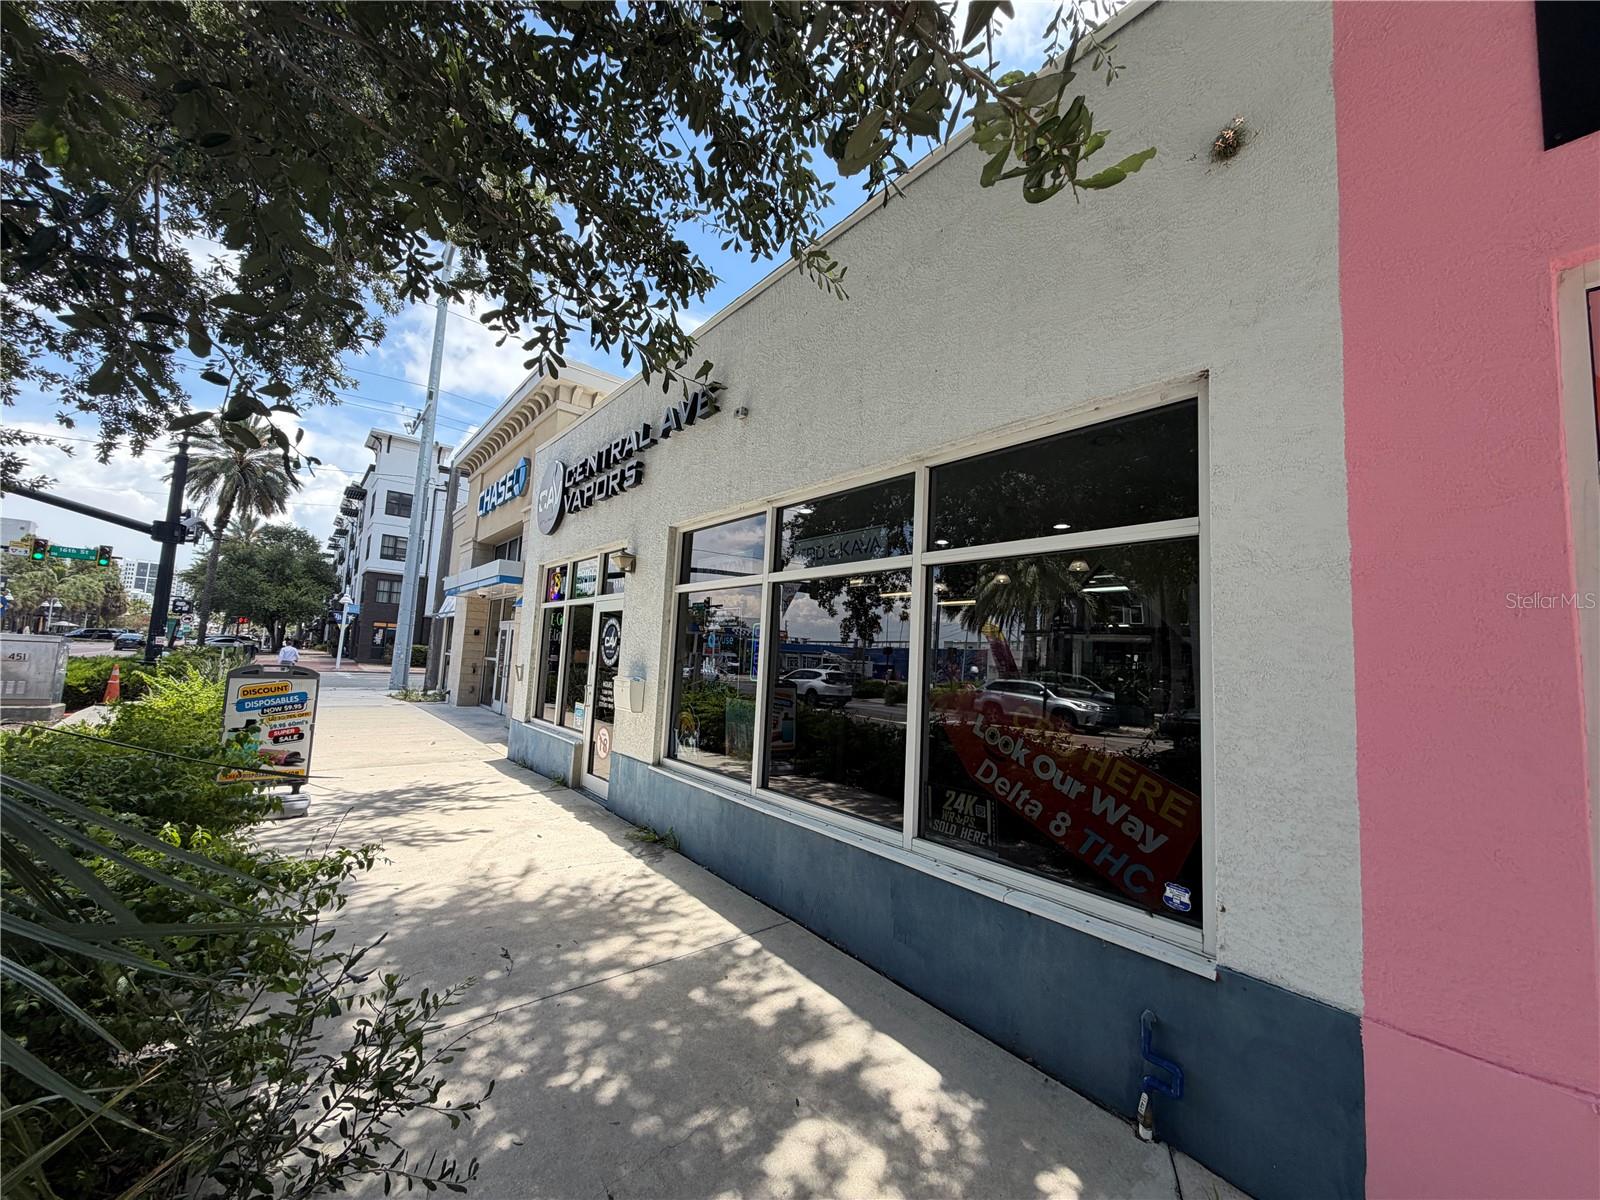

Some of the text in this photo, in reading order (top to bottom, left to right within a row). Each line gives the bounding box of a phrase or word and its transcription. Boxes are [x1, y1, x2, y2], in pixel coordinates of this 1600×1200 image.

[565, 386, 720, 488] CENTRAL AVE
[477, 469, 516, 517] CHASE
[539, 472, 562, 512] CAV
[564, 460, 644, 514] VAPORS
[840, 535, 881, 557] KAVA
[8, 652, 26, 661] 451
[242, 684, 289, 696] DISCOUNT
[244, 695, 300, 709] DISPOSABLES
[263, 704, 302, 714] NOW $9.95
[273, 728, 295, 736] SUPER
[279, 734, 299, 742] SALE
[972, 713, 1031, 768] Look
[1032, 754, 1087, 799] Our
[1090, 786, 1169, 853] Way
[1083, 752, 1193, 828] HERE
[942, 790, 978, 817] 24K
[933, 819, 988, 845] SOLD HERE
[975, 758, 1155, 894] Delta 8 THC
